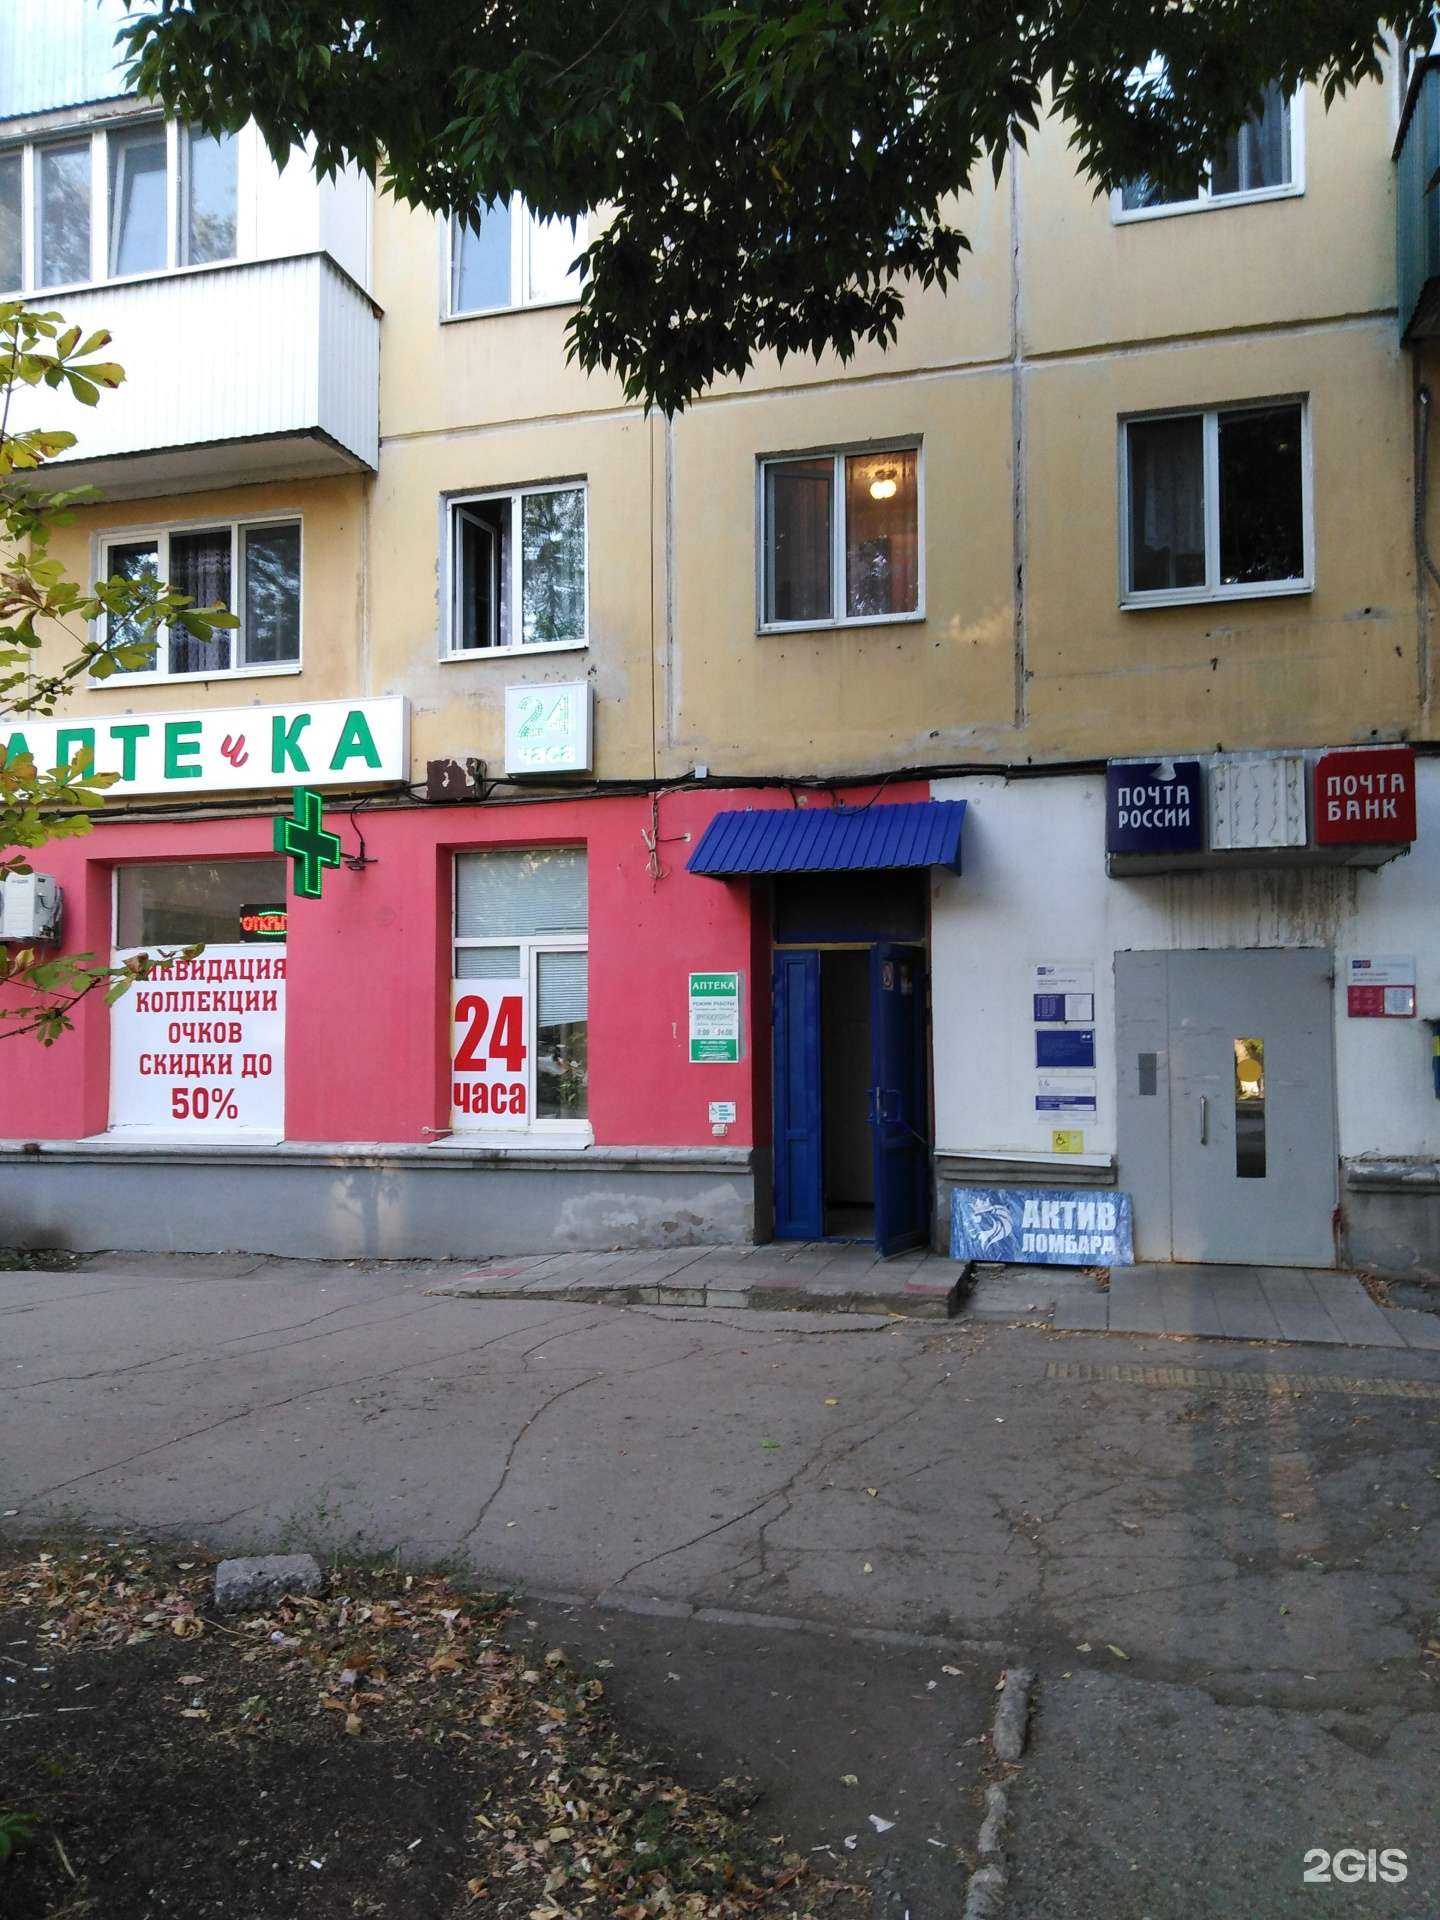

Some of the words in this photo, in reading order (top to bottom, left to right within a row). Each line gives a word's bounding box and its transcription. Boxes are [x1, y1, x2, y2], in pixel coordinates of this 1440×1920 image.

[518, 692, 571, 737] 24
[1118, 785, 1190, 807] ПОЧТА
[1327, 773, 1405, 796] ПОЧТА
[1118, 808, 1190, 829] РОССИИ
[1327, 798, 1398, 821] БАНК
[140, 958, 287, 983] ИКВИДАЦИЯ
[692, 981, 735, 991] АПТЕКА
[136, 990, 278, 1014] КОЛЛЕКЦИИ
[168, 1022, 243, 1043] ОЧКОВ
[454, 994, 527, 1072] 24
[139, 1053, 233, 1078] СКИДКИ
[241, 1053, 272, 1078] ДО
[172, 1087, 239, 1119] 50%
[453, 1082, 526, 1115] часа
[1021, 1199, 1117, 1231] АКТИВ
[1021, 1232, 1116, 1255] ЛОМБАРД
